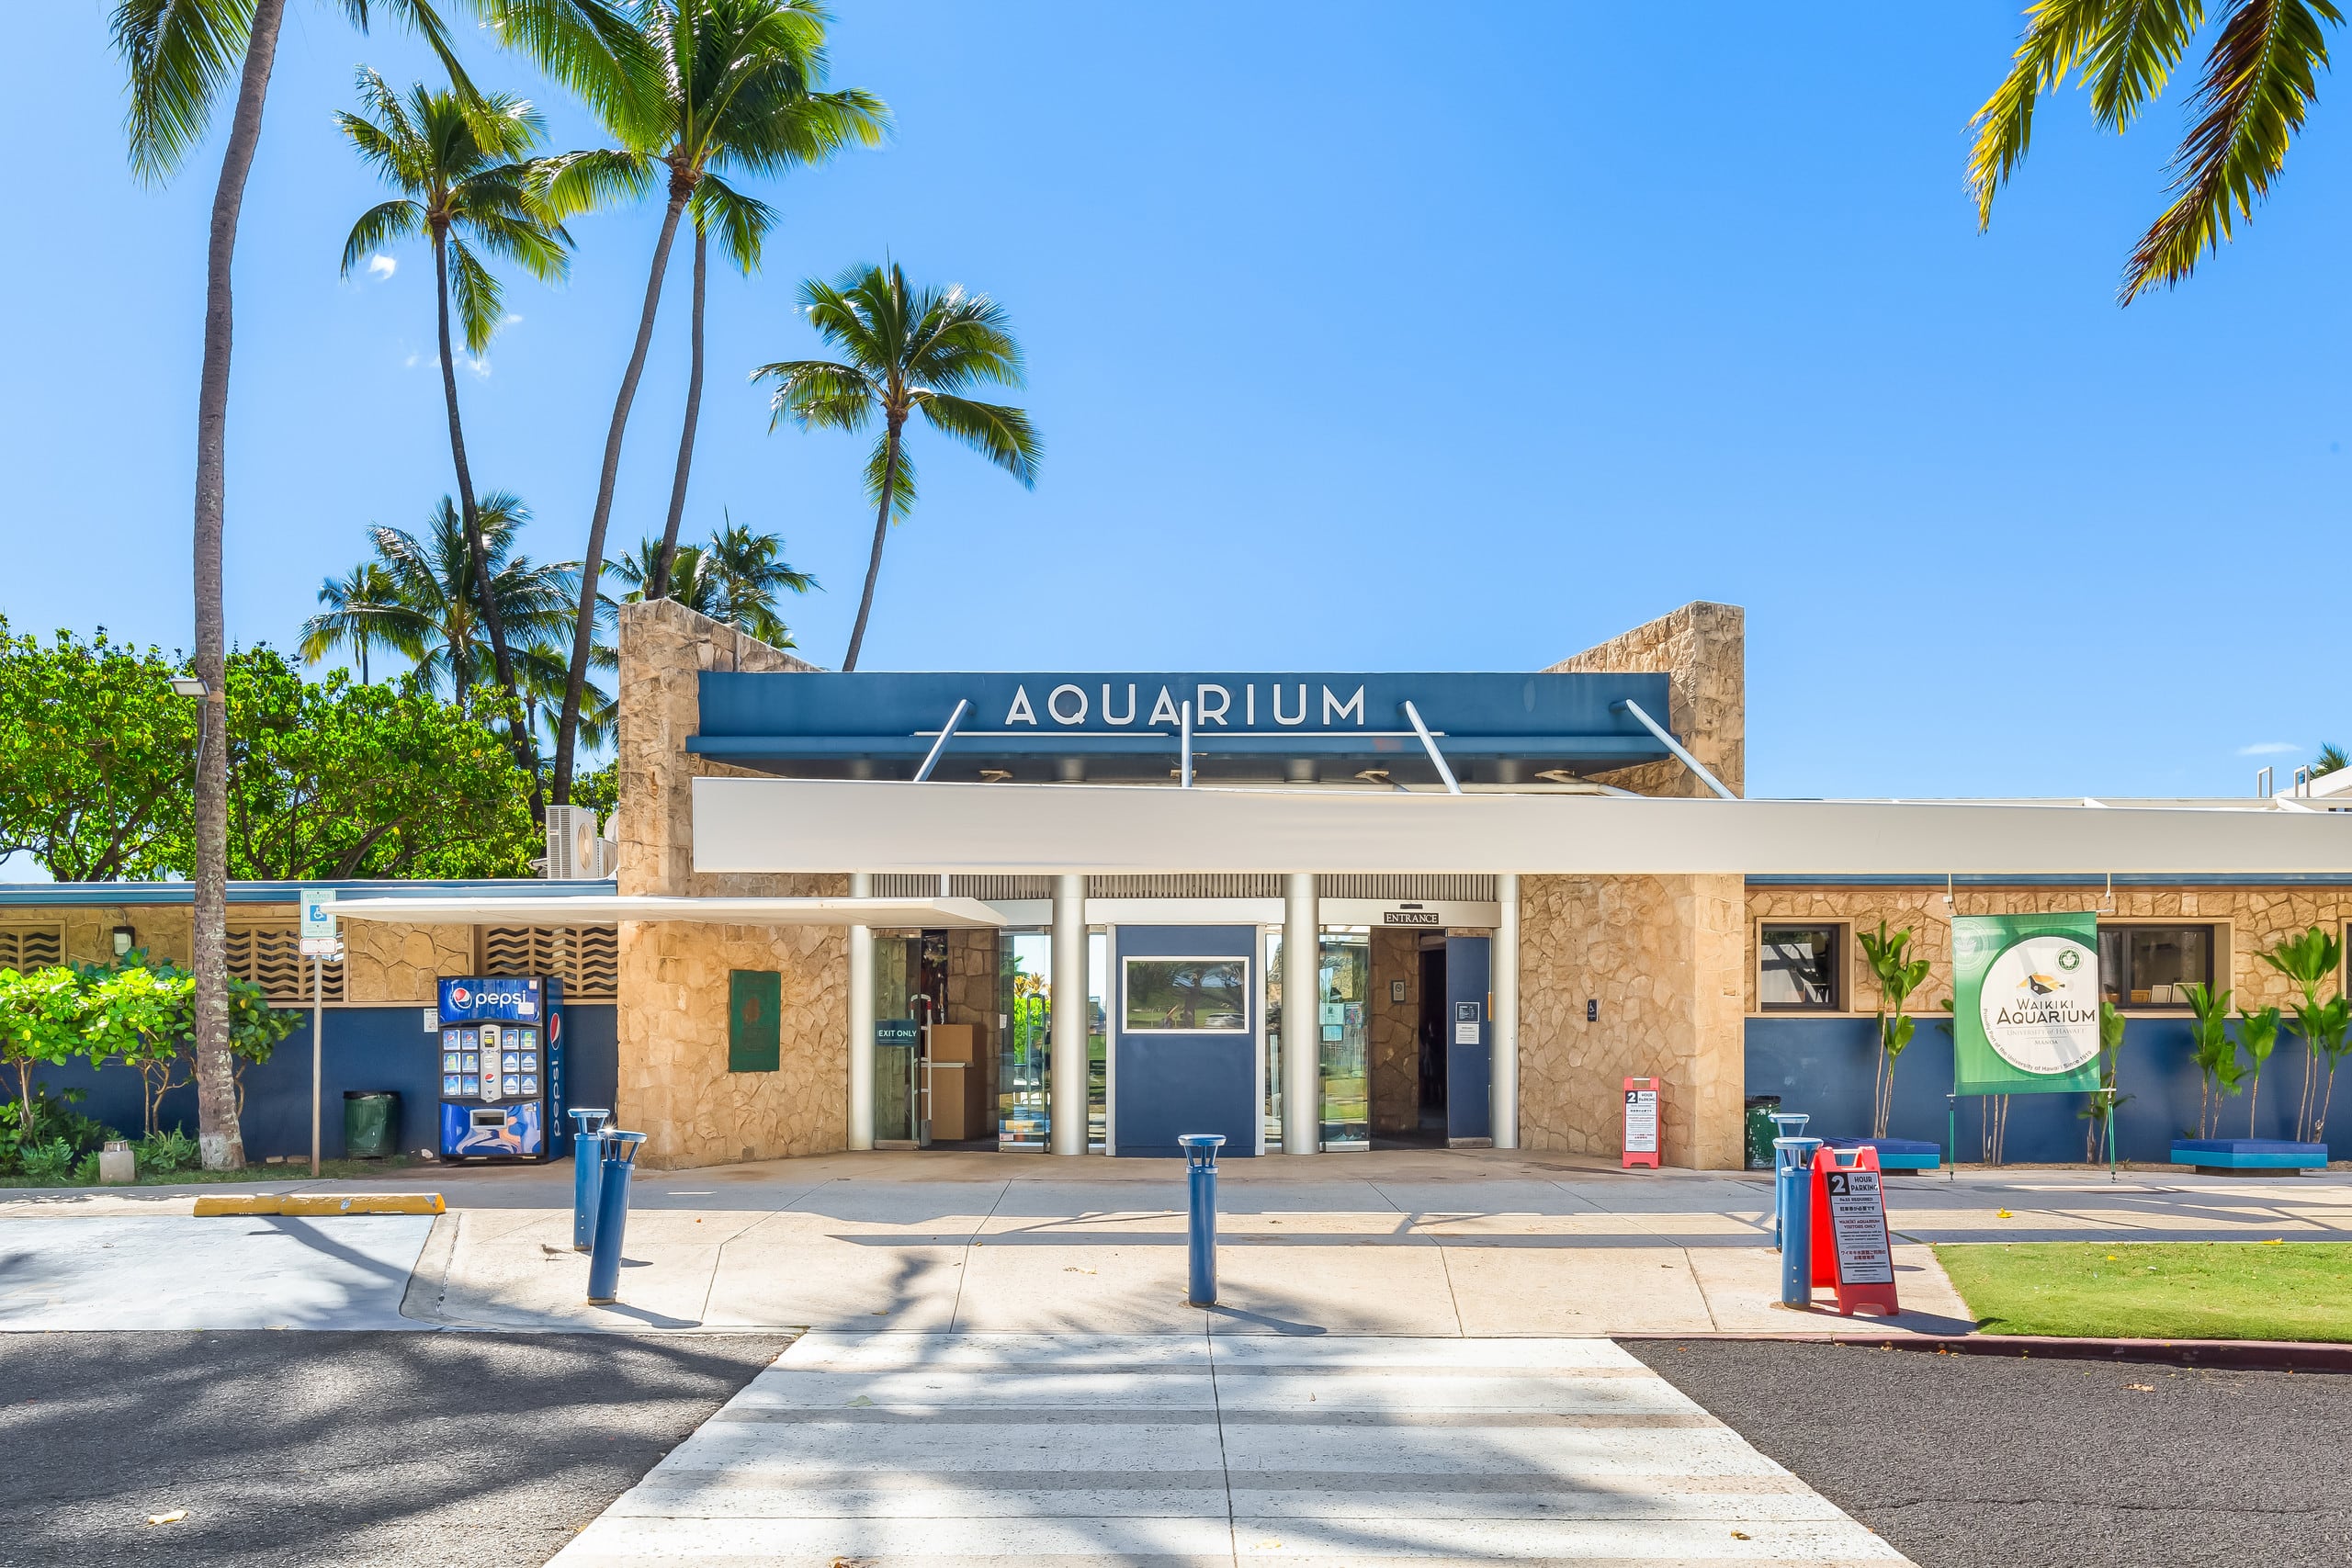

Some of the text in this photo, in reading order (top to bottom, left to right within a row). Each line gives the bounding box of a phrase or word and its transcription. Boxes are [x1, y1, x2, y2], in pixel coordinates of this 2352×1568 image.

[1005, 683, 1364, 726] AQUARIUM
[1385, 914, 1438, 924] ENTRANCE
[475, 989, 526, 1009] pepsi
[1996, 1007, 2096, 1025] AQUARIUM
[2007, 1054, 2033, 1071] University
[2064, 1058, 2080, 1069] Since
[2080, 1050, 2092, 1061] 1919
[551, 1060, 560, 1137] pepsi
[1627, 1092, 1636, 1102] 2
[1831, 1175, 1847, 1193] 2
